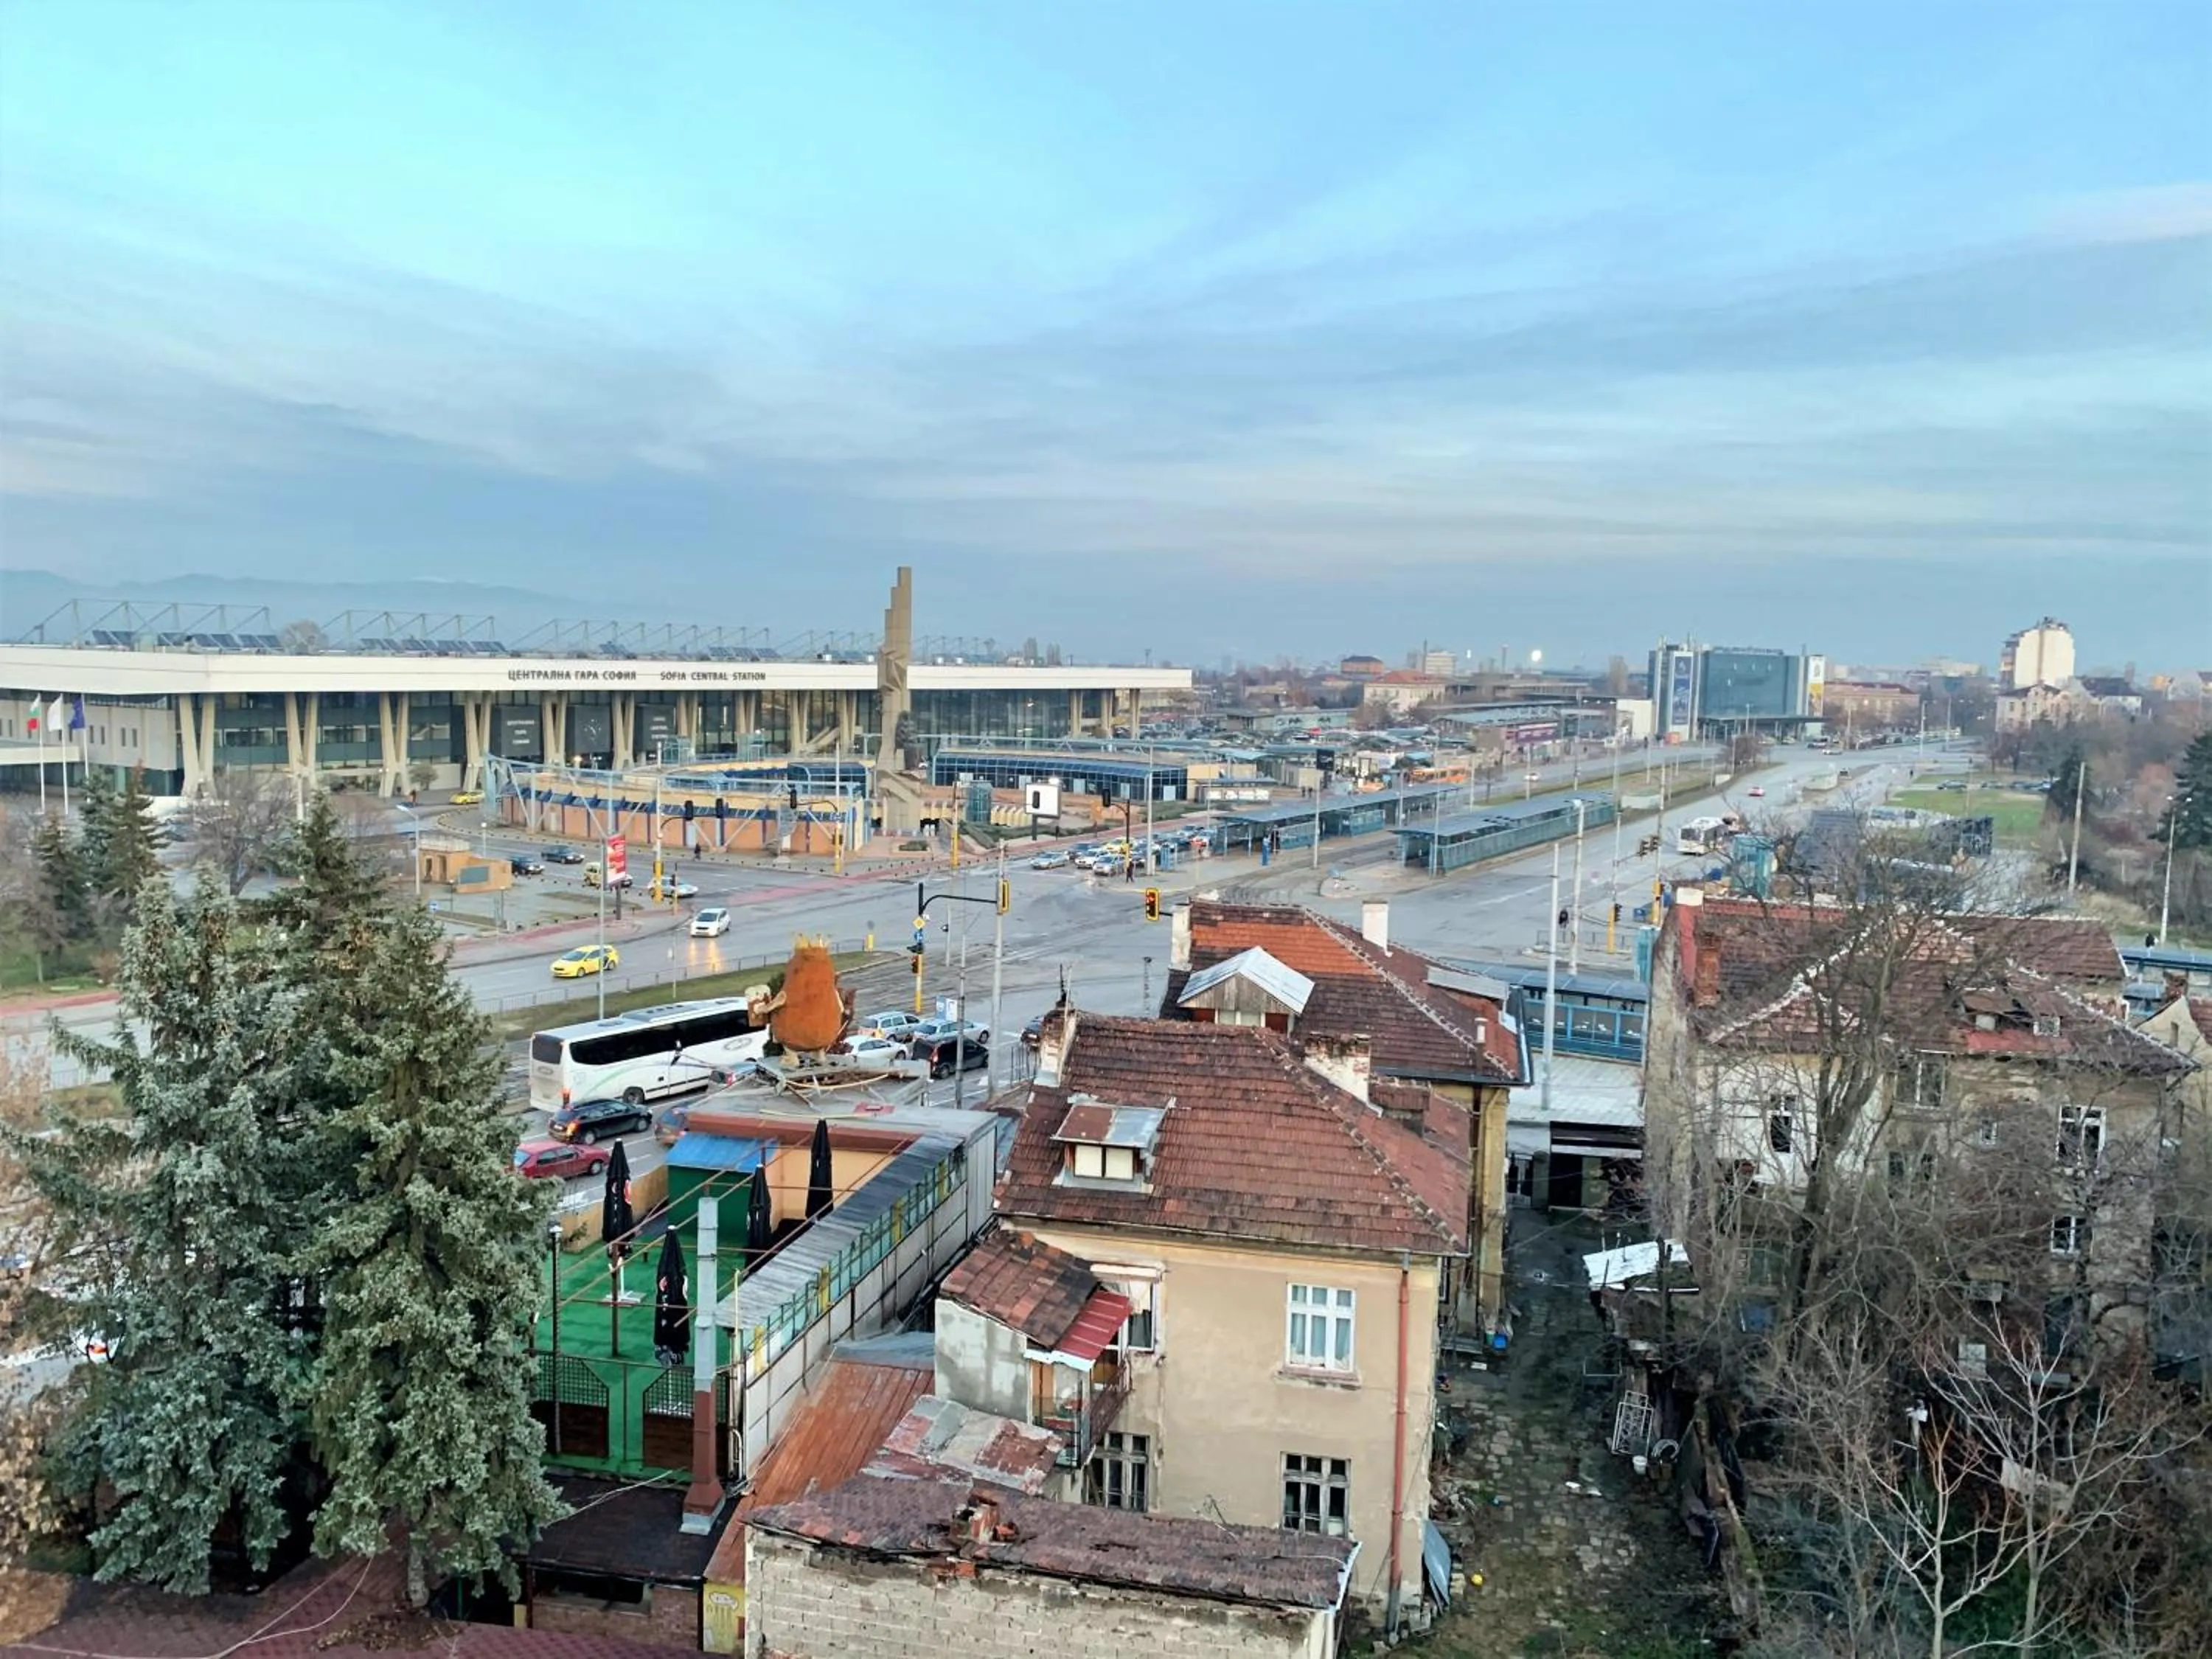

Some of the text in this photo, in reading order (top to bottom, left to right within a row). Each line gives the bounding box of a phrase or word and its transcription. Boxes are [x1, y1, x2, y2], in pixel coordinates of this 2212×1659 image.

[508, 670, 636, 681] ЦЕНТРАЛНА ГАРА СОФИЯ
[661, 672, 766, 680] SOFIA CENTRAL STATION
